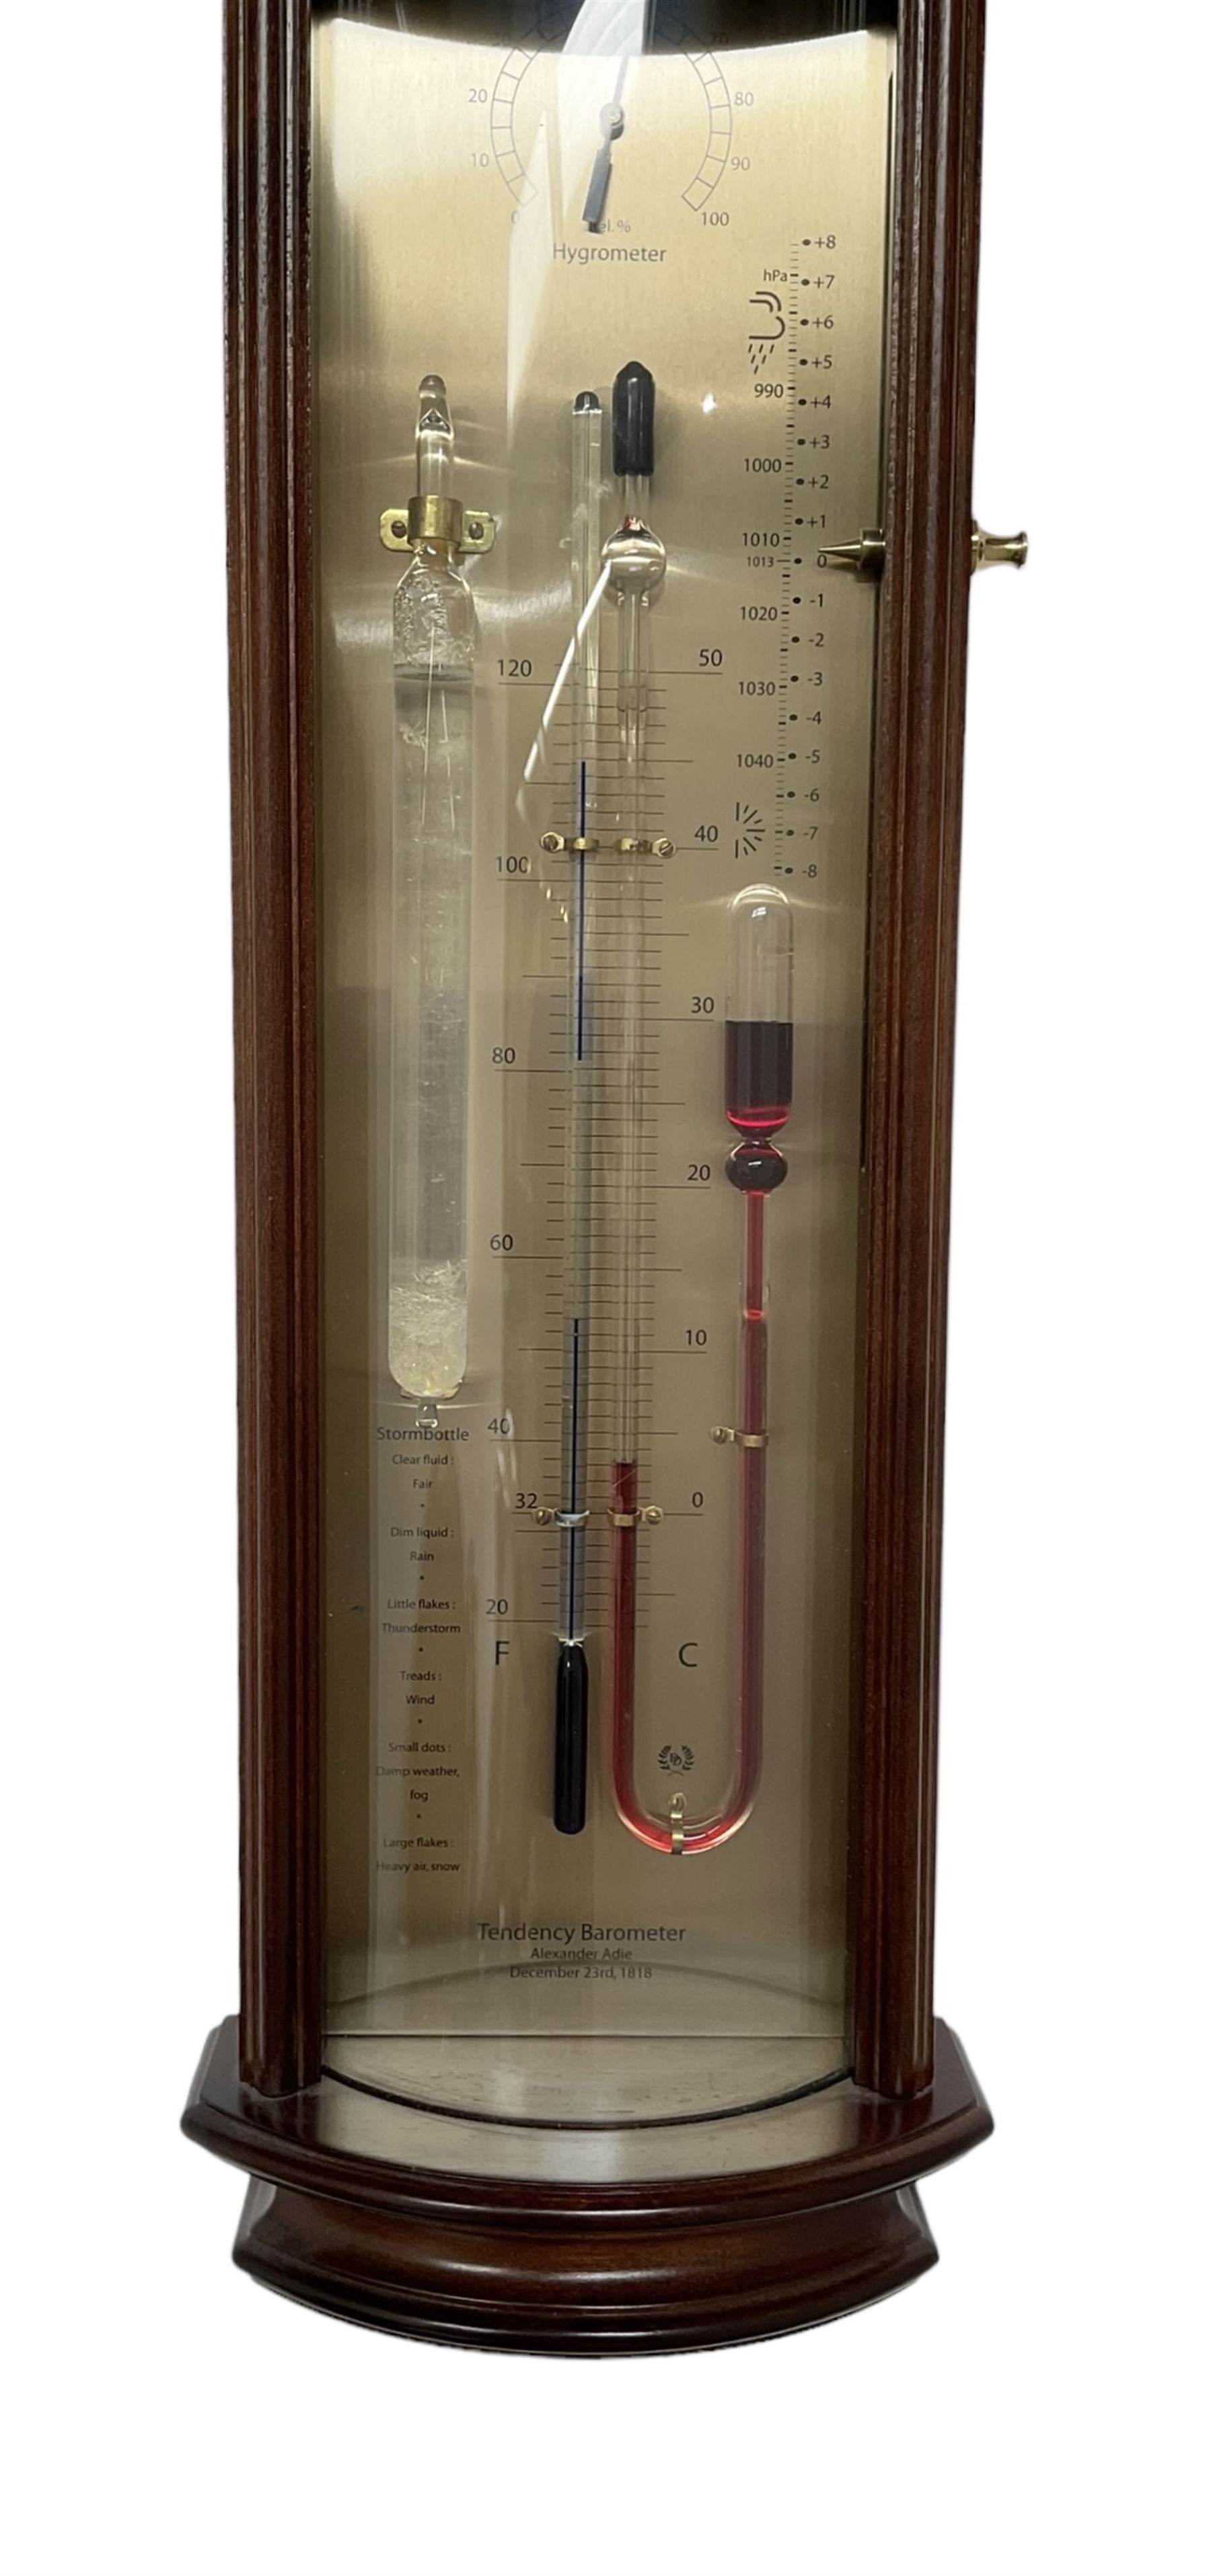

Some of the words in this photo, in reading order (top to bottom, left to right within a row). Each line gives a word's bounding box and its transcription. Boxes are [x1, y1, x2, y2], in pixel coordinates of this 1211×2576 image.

[468, 89, 487, 103] 20
[734, 92, 754, 106] 80
[472, 154, 488, 168] 10
[731, 157, 750, 171] 90
[511, 211, 520, 225] 0
[701, 213, 729, 227] 100
[815, 236, 836, 248] +8
[553, 243, 666, 264] Hygrometer
[764, 270, 787, 282] hPa
[814, 276, 834, 288] +7
[813, 316, 834, 328] +6
[812, 356, 832, 368] +5
[754, 384, 783, 397] 990
[811, 396, 832, 408] +4
[809, 436, 830, 448] +3
[745, 459, 781, 472] 1000
[809, 476, 829, 488] +2
[808, 515, 825, 528] +1
[742, 533, 779, 546] 1010
[747, 557, 774, 567] 1013
[817, 555, 827, 568] 0
[810, 594, 823, 607] -1
[741, 607, 777, 620] 1020
[809, 634, 823, 646] -2
[699, 650, 722, 667] 50
[498, 661, 532, 677] 120
[808, 673, 823, 686] -3
[739, 682, 776, 695] 1030
[807, 712, 821, 724] -4
[737, 754, 774, 768] 1040
[806, 751, 819, 763] -5
[805, 789, 819, 801] -6
[694, 826, 718, 843] 40
[804, 828, 817, 839] -7
[496, 855, 529, 873] 100
[803, 865, 817, 877] -8
[691, 997, 714, 1014] 30
[492, 1048, 515, 1064] 80
[688, 1165, 710, 1182] 20
[490, 1235, 513, 1251] 60
[686, 1330, 707, 1347] 10
[488, 1419, 510, 1434] 40
[377, 1427, 469, 1441] Stormbottle
[392, 1455, 420, 1464] Clear
[423, 1454, 447, 1464] fluid
[413, 1479, 433, 1489] Fair
[515, 1493, 538, 1509] 32
[692, 1493, 703, 1508] 0
[391, 1528, 413, 1537] Dim
[417, 1528, 447, 1540] liquid
[410, 1552, 434, 1561] Rain
[388, 1600, 416, 1609] Little
[418, 1599, 449, 1609] flakes
[486, 1600, 508, 1615] 20
[382, 1624, 460, 1633] Thunderstorm
[494, 1641, 510, 1665] F
[679, 1643, 698, 1668] C
[400, 1671, 435, 1680] Treads
[406, 1694, 434, 1704] Wind
[389, 1743, 418, 1752] Small
[422, 1742, 445, 1752] dots
[377, 1766, 410, 1779] Damp
[413, 1766, 460, 1777] weather,
[410, 1790, 428, 1802] fog
[383, 1838, 414, 1849] Large
[417, 1837, 447, 1847] flakes
[377, 1862, 410, 1873] Heavy
[413, 1862, 429, 1872] air,
[478, 1923, 575, 1944] Tendency
[582, 1924, 685, 1941] Barometer
[531, 1948, 599, 1959] Alexander
[603, 1948, 632, 1959] Adie
[510, 1967, 579, 1978] December
[584, 1967, 616, 1980] 23rd,
[621, 1968, 651, 1978] 1818
